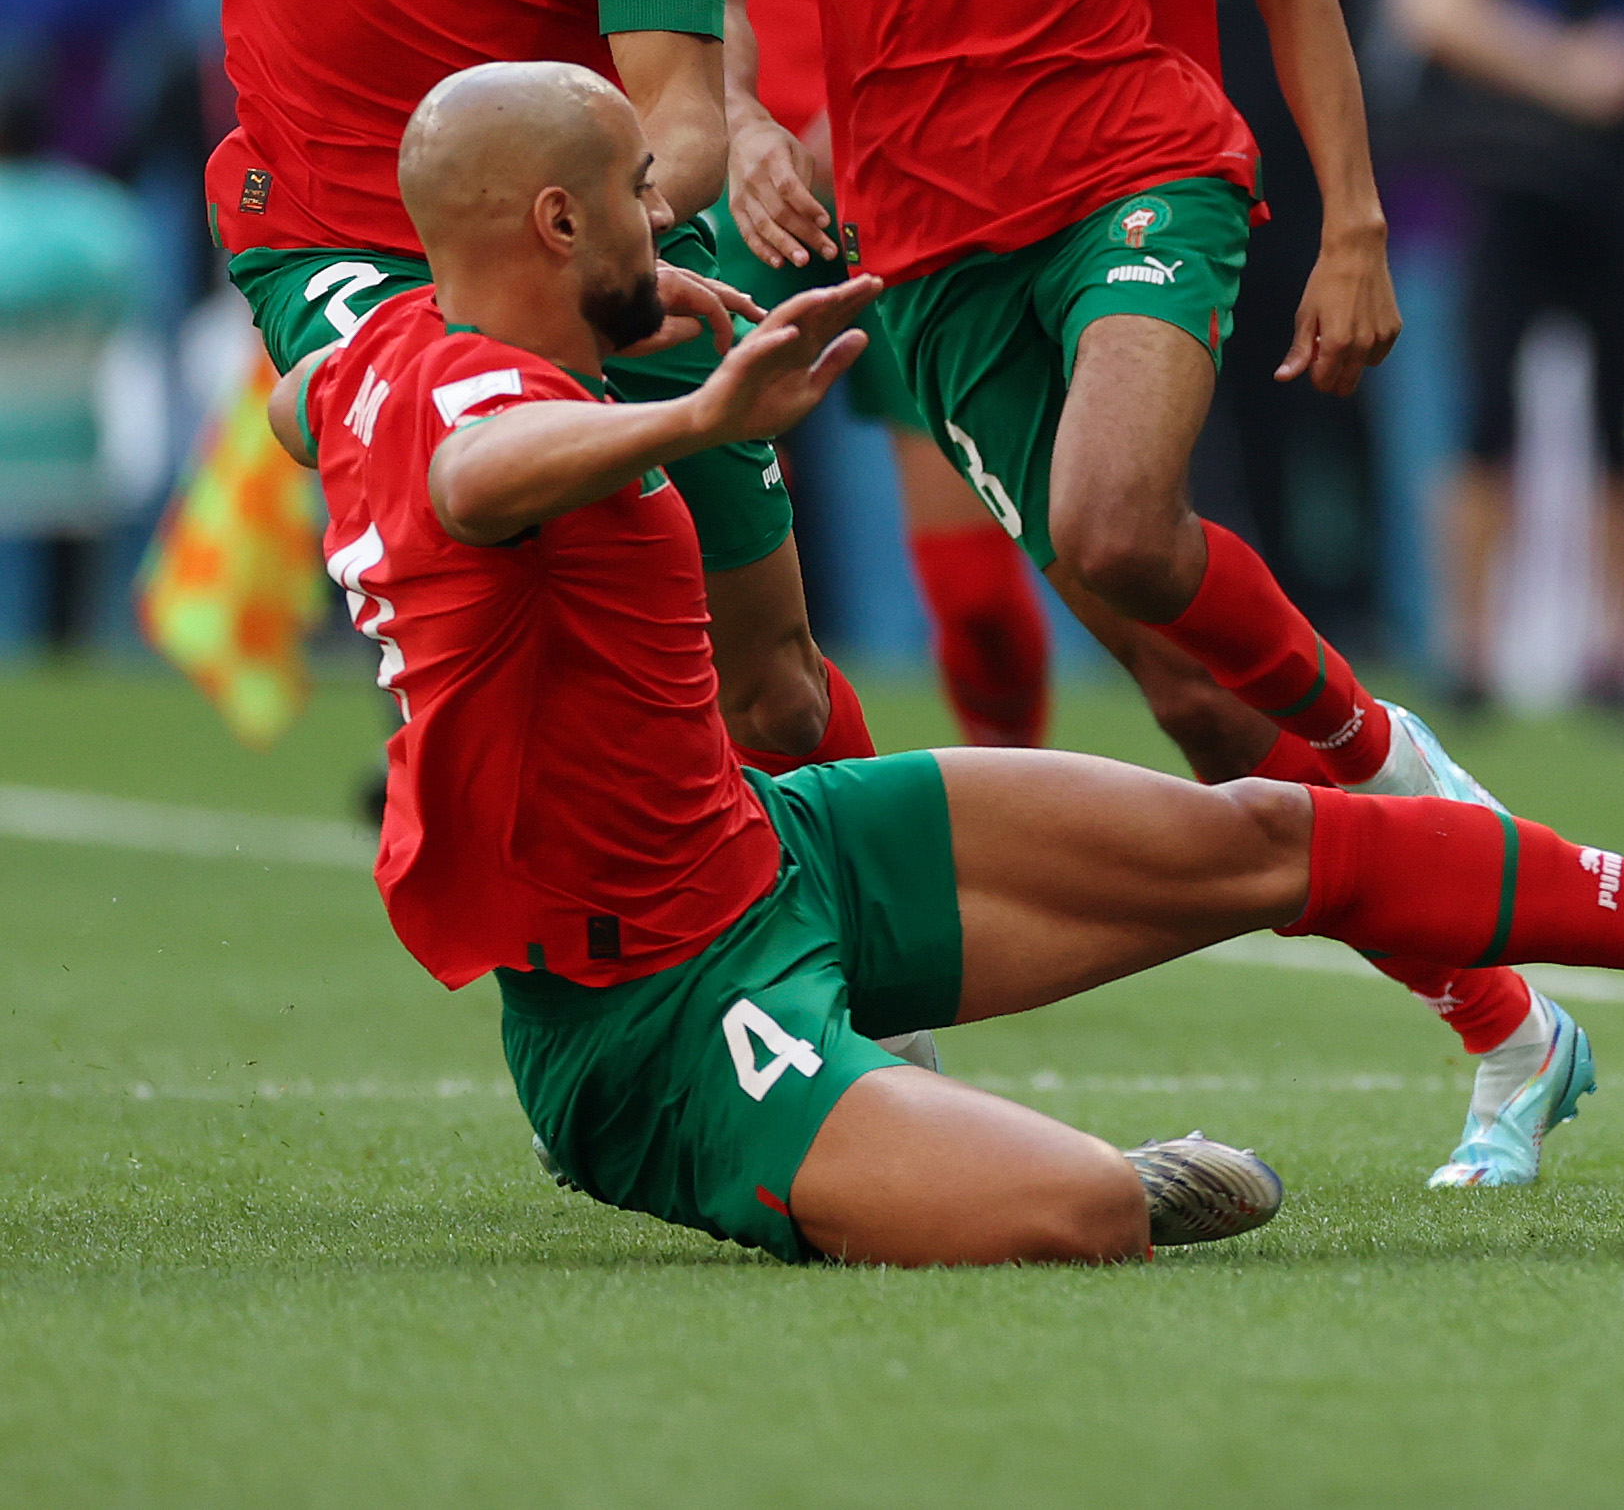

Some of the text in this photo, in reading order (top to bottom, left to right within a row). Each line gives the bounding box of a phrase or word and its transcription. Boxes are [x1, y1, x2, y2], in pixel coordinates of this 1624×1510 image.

[304, 262, 389, 348] 2
[1106, 265, 1165, 285] PUMA
[722, 998, 823, 1102] 4
